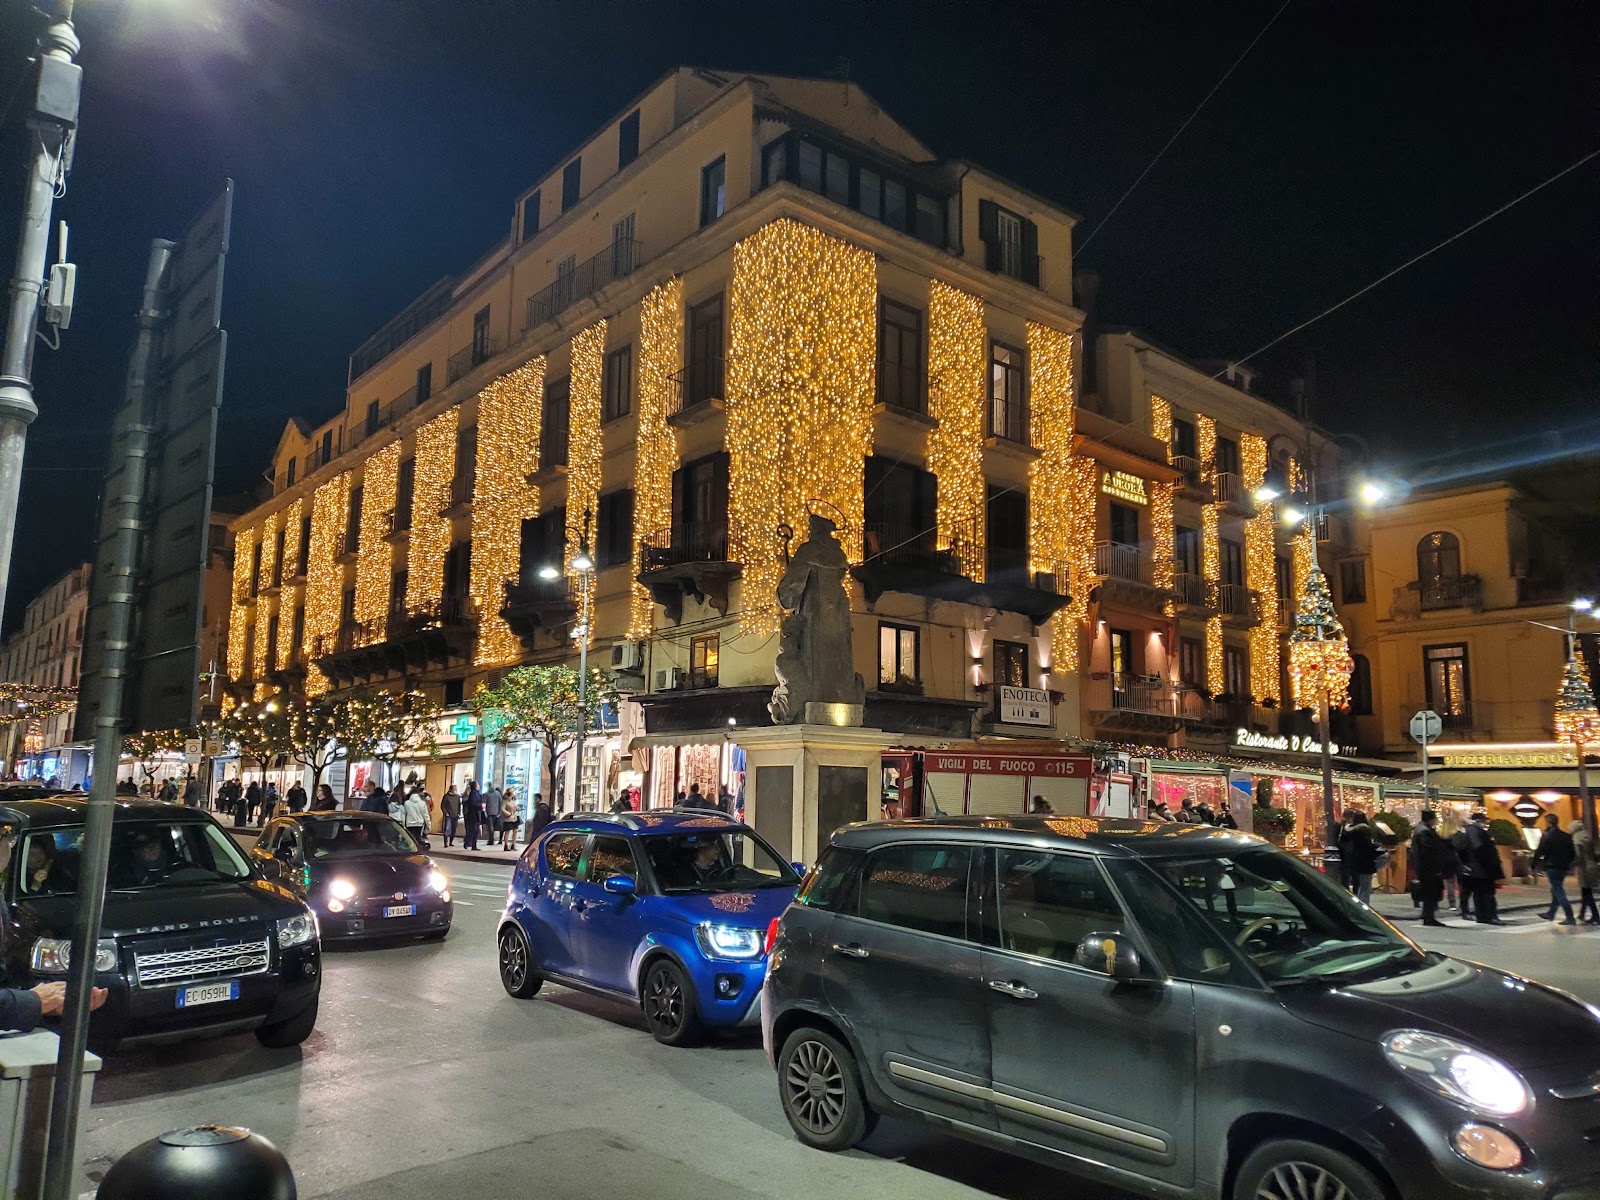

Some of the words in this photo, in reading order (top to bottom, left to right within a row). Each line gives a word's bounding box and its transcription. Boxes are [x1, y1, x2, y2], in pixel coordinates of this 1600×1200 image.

[1103, 472, 1147, 496] AURORA
[1003, 688, 1048, 703] ENOTECA
[1236, 728, 1289, 750] Ristorante
[938, 758, 966, 770] VIGILI
[972, 759, 992, 770] DEL
[999, 760, 1036, 772] FUOCO
[1055, 762, 1075, 774] 115
[1444, 755, 1513, 765] PIZZERIA
[136, 923, 189, 934] LAND
[199, 915, 259, 927] ROVER
